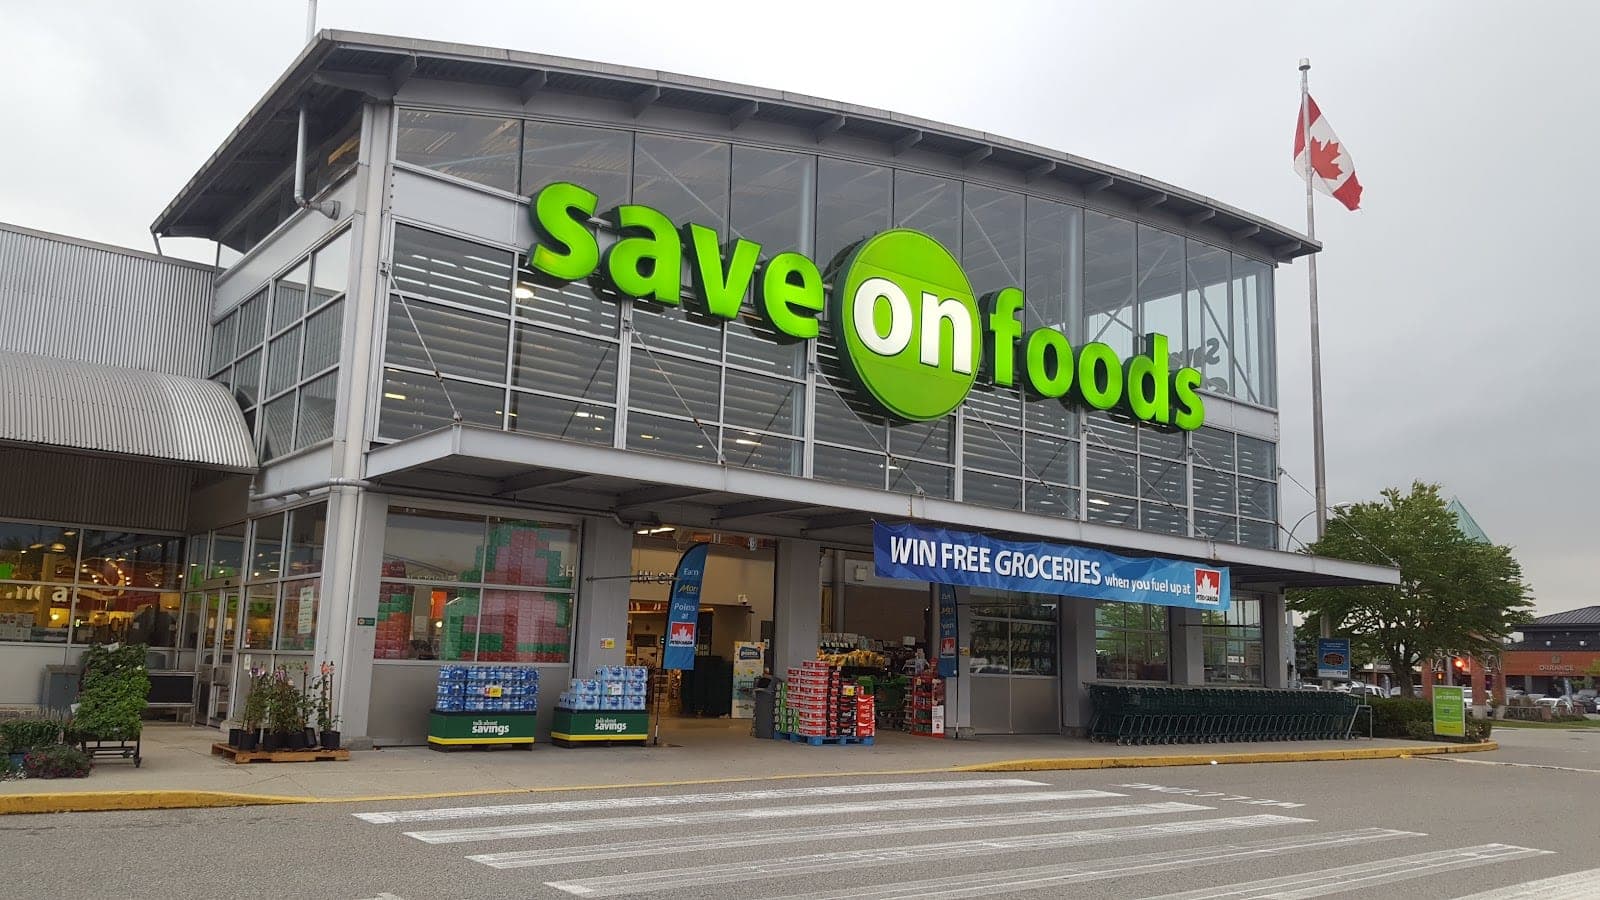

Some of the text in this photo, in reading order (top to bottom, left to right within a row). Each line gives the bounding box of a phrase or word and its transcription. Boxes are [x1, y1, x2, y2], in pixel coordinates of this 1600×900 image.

[530, 181, 1206, 432] save on foods
[890, 535, 1191, 596] WIN FREE GROCERIES when you fuel up at
[471, 724, 510, 735] savings
[594, 722, 627, 732] savings
